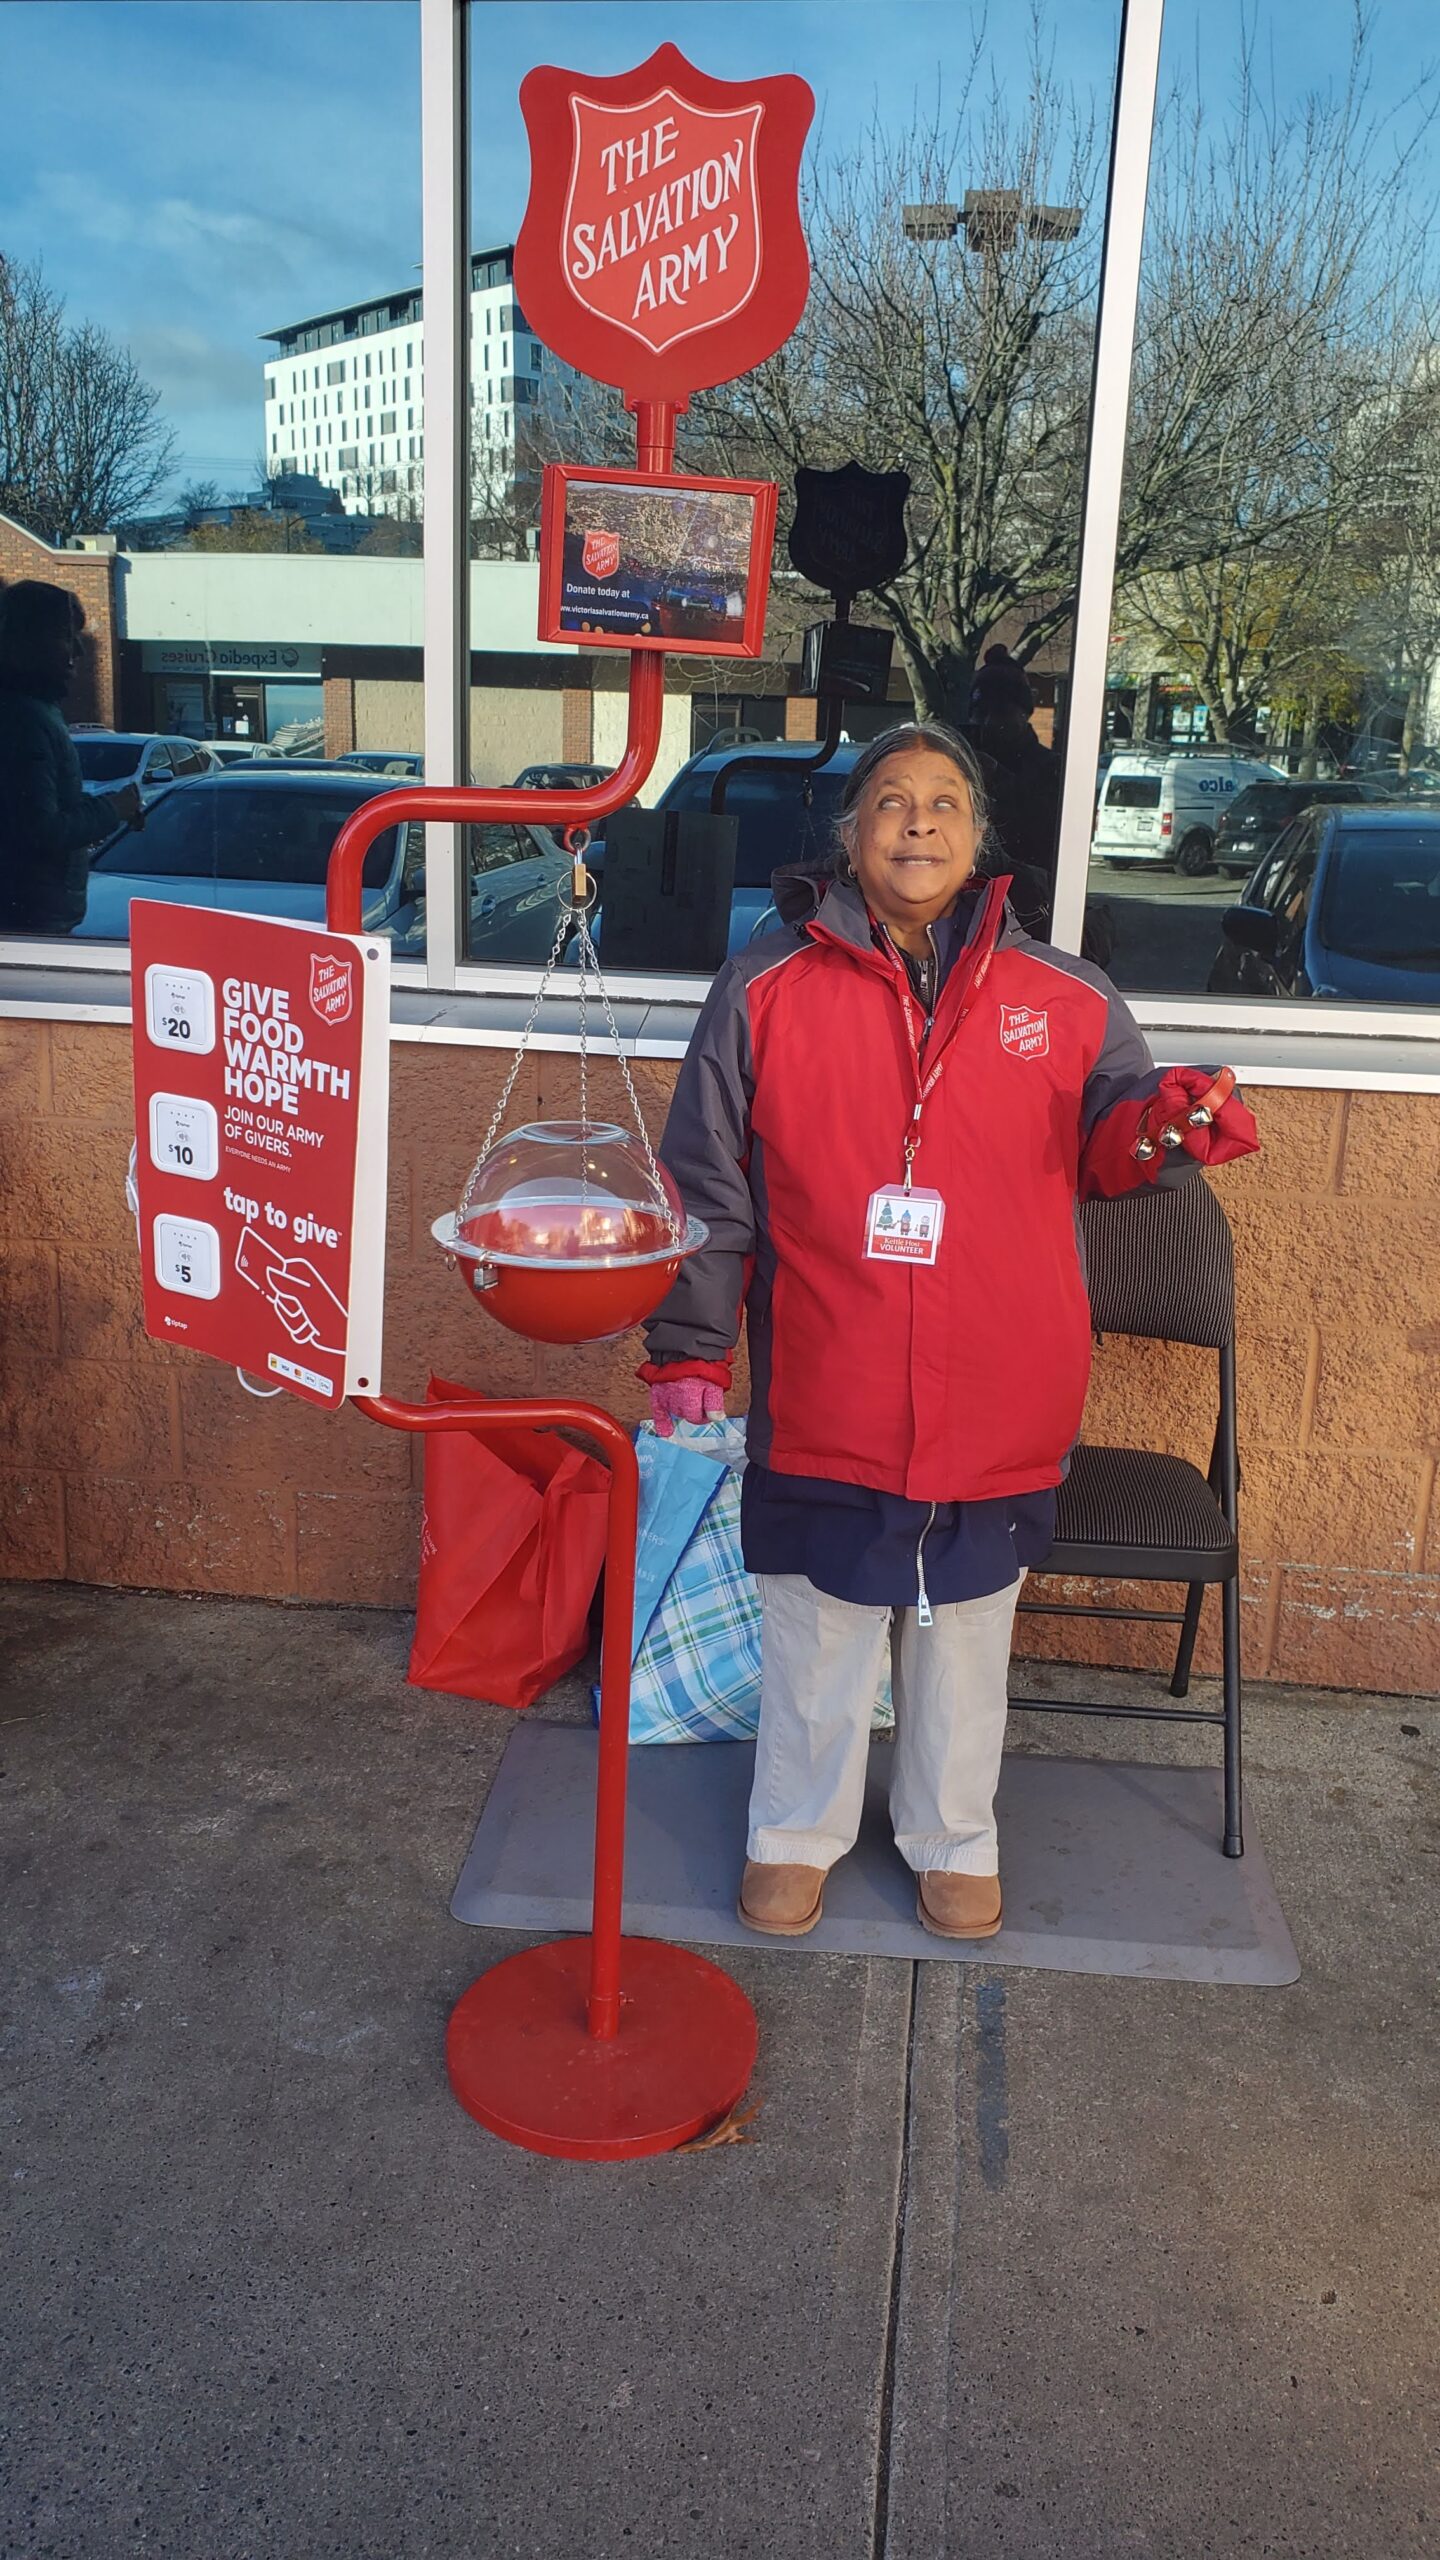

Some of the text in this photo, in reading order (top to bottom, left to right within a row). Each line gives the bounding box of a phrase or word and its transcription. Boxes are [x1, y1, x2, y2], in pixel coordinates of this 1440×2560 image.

[600, 116, 680, 196] THE
[571, 138, 745, 281] SALVATION
[631, 213, 740, 320] ARMY
[596, 555, 616, 573] ARMY
[566, 583, 630, 599] Donate today at
[313, 972, 348, 1002] SALVATION
[318, 964, 335, 983] THE
[222, 977, 290, 1021] GIVE
[324, 990, 347, 1014] ARMY
[161, 1017, 191, 1039] $20
[223, 1007, 304, 1054] FOOD
[1003, 1018, 1044, 1044] SALVATION
[1008, 1011, 1029, 1026] THE
[1018, 1033, 1043, 1053] ARMY
[223, 1036, 350, 1100] WARMTH
[224, 1066, 299, 1115] HOPE
[224, 1105, 324, 1148] JOIN OUR ARMY
[224, 1123, 293, 1157] OF GIVERS.
[168, 1144, 193, 1165] $10
[225, 1145, 292, 1173] EVERYONE NEEDS AN ARMY
[223, 1186, 259, 1224] tap
[264, 1201, 287, 1229] to
[880, 1243, 924, 1255] VOLUNTEER
[884, 1237, 904, 1246] Kettle
[175, 1264, 191, 1283] $5
